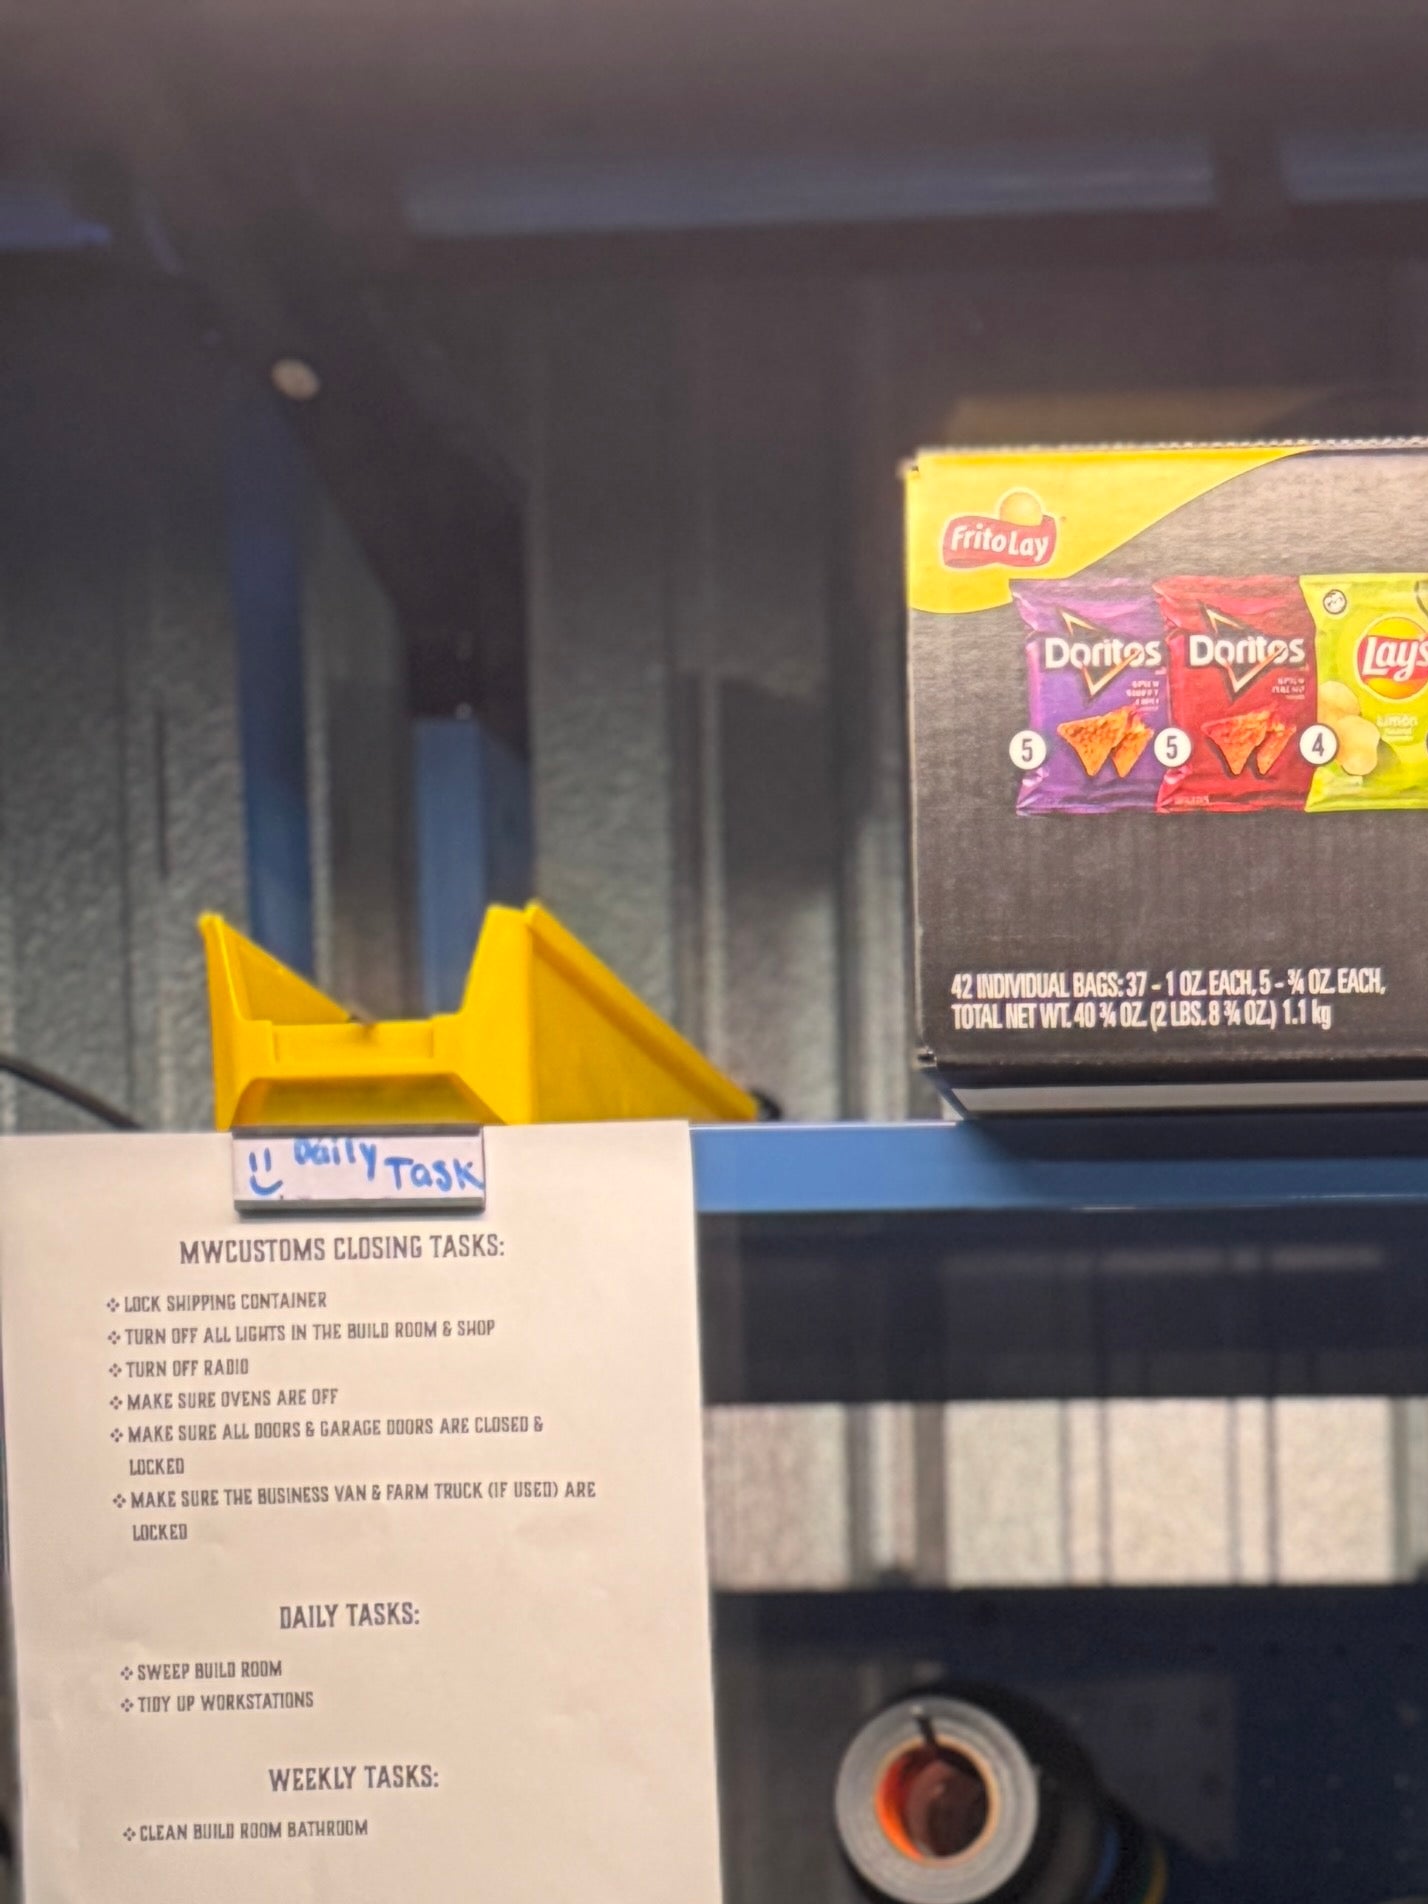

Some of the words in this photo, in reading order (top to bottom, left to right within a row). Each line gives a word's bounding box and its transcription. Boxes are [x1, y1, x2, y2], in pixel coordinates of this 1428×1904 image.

[1045, 636, 1163, 670] Doritos
[1189, 634, 1306, 668] Doritos
[1020, 738, 1034, 762] 5
[1165, 736, 1178, 760] 5
[1311, 732, 1325, 757] 4
[951, 973, 973, 1000] 42
[976, 973, 1070, 999] INDIVIDUAL
[1073, 972, 1124, 998] BAGS:
[1126, 971, 1147, 998] 37
[1166, 971, 1175, 997] 1
[1209, 970, 1258, 997] EACH,
[1259, 969, 1271, 996] 5
[1337, 968, 1386, 996] EACH,
[951, 1004, 1004, 1030] TOTAL
[1006, 1004, 1037, 1029] NET
[1038, 1003, 1073, 1029] WT.
[1073, 1002, 1097, 1028] 40
[1149, 1000, 1168, 1031] (2
[1170, 1001, 1208, 1027] LBS.
[1208, 1000, 1220, 1026] 8
[1281, 999, 1308, 1025] 1.1
[1311, 997, 1333, 1030] kg
[384, 1157, 486, 1192] Task
[179, 1237, 326, 1265] MWCUSTOMS
[333, 1235, 423, 1261] CLOSING
[429, 1233, 506, 1258] TASKS:
[124, 1295, 161, 1313] LOCK
[166, 1294, 237, 1312] SHIPPING
[240, 1292, 328, 1310] CONTAINER
[125, 1328, 167, 1346] TURN
[171, 1328, 198, 1345] OFF
[203, 1327, 232, 1344] ALL
[235, 1325, 286, 1343] LIGHTS
[291, 1324, 308, 1341] IN
[312, 1323, 342, 1341] THE
[347, 1322, 389, 1340] BUILD
[394, 1321, 438, 1339] ROOM
[442, 1320, 452, 1338] &
[457, 1319, 496, 1337] SHOP
[126, 1361, 168, 1378] TURN
[172, 1360, 199, 1377] OFF
[203, 1358, 250, 1376] RADIO
[127, 1393, 174, 1411] MAKE
[177, 1391, 217, 1409] SURE
[220, 1390, 272, 1408] OVENS
[276, 1389, 307, 1406] ARE
[311, 1388, 339, 1405] OFF
[127, 1425, 174, 1443] MAKE
[178, 1424, 218, 1442] SURE
[221, 1423, 250, 1441] ALL
[254, 1421, 302, 1440] DOORS
[305, 1421, 316, 1438] &
[320, 1419, 382, 1437] GARAGE
[386, 1418, 434, 1436] DOORS
[439, 1417, 470, 1435] ARE
[474, 1415, 529, 1434] CLOSED
[533, 1415, 544, 1432] &
[128, 1457, 186, 1477] LOCKED
[130, 1490, 177, 1509] MAKE
[180, 1489, 220, 1507] SURE
[223, 1488, 253, 1506] THE
[256, 1486, 330, 1505] BUSINESS
[333, 1484, 367, 1502] VAN
[371, 1484, 382, 1501] &
[386, 1483, 430, 1501] FARM
[433, 1482, 484, 1500] TRUCK
[487, 1481, 508, 1500] (IF
[513, 1481, 559, 1499] USED)
[563, 1480, 597, 1499] ARE
[132, 1523, 189, 1542] LOCKED
[279, 1603, 339, 1630] DAILY
[345, 1601, 420, 1626] TASKS:
[137, 1663, 190, 1681] SWEEP
[194, 1661, 236, 1680] BUILD
[240, 1660, 283, 1678] ROOM
[137, 1695, 171, 1713] TIDY
[176, 1695, 196, 1713] UP
[200, 1691, 315, 1711] WORKSTATIONS
[268, 1765, 358, 1793] WEEKLY
[363, 1763, 440, 1789] TASKS:
[139, 1823, 188, 1842] CLEAN
[192, 1822, 235, 1840] BUILD
[239, 1821, 283, 1839] ROOM
[287, 1819, 369, 1838] BATHROOM
